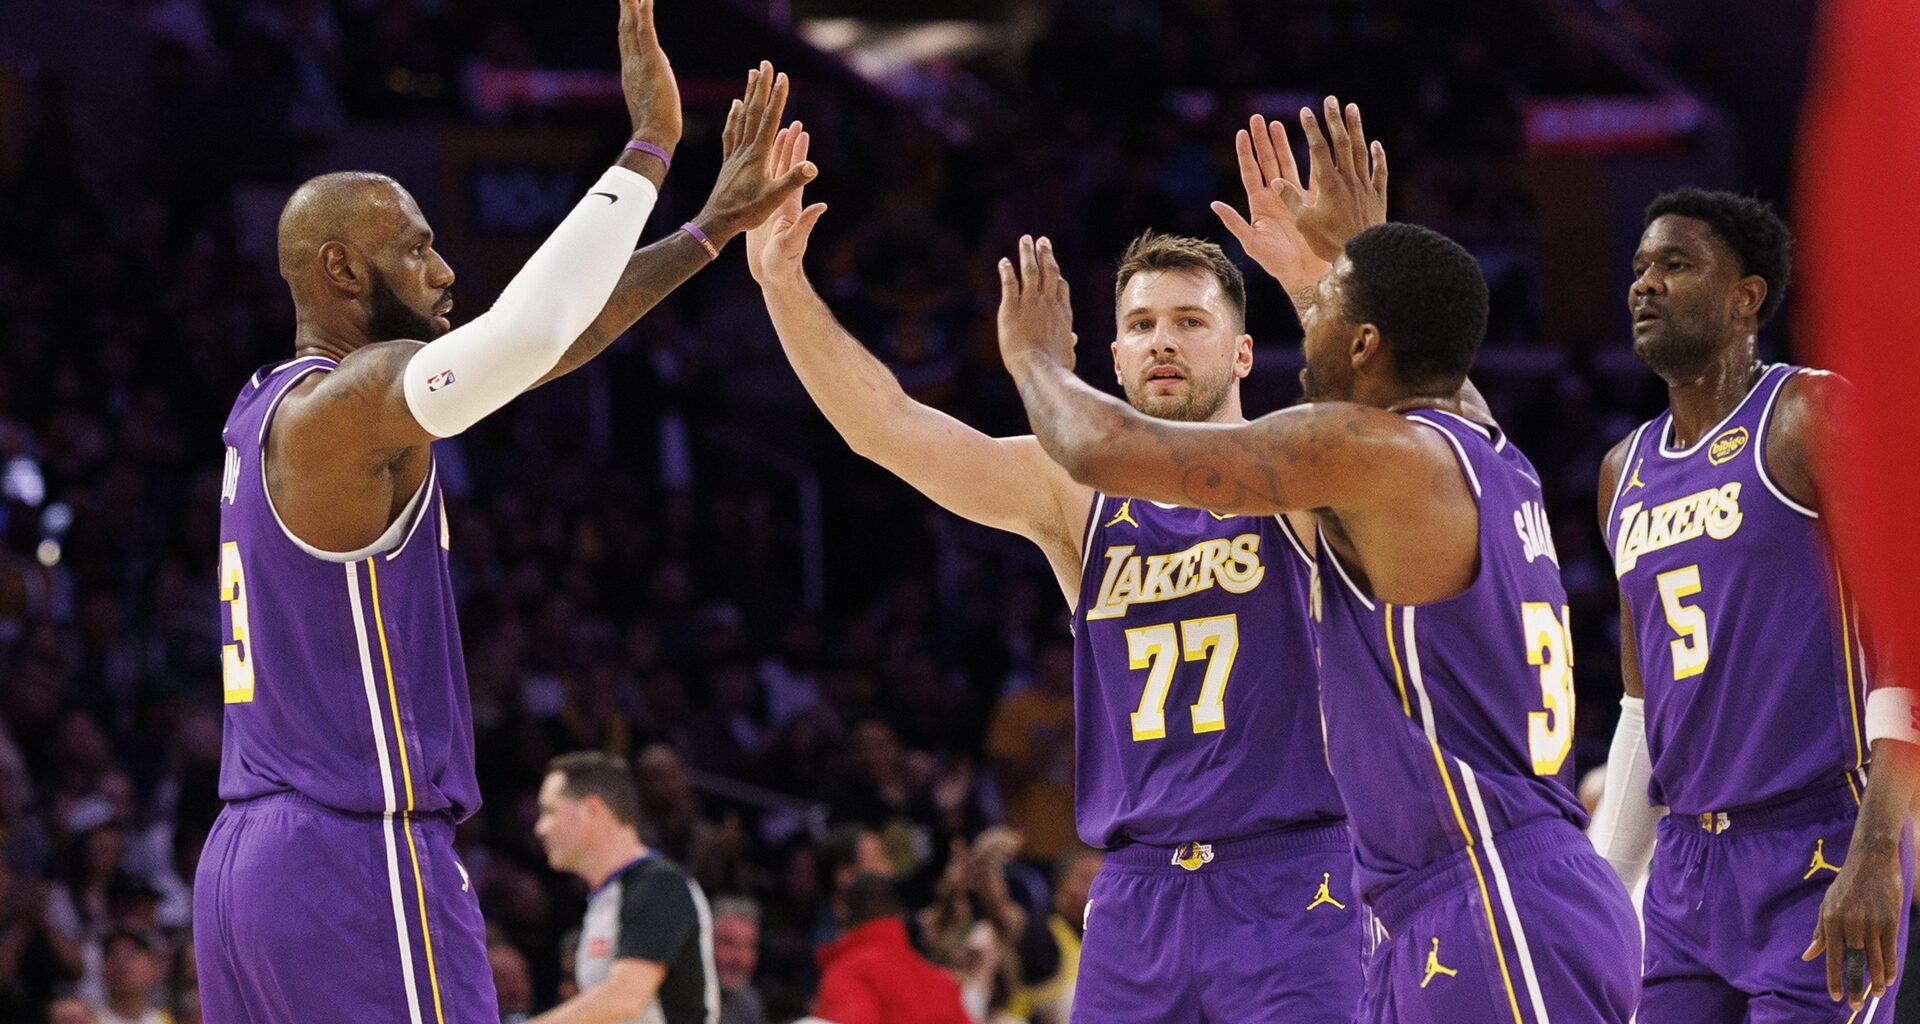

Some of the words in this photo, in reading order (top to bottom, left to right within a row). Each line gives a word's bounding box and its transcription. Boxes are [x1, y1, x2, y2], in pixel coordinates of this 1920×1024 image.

[1085, 533, 1266, 621] LAKERS
[1614, 481, 1744, 582] LAKERS
[218, 541, 255, 704] 3
[1124, 613, 1240, 742] 77
[1656, 563, 1711, 681] 5
[1520, 602, 1576, 776] 3
